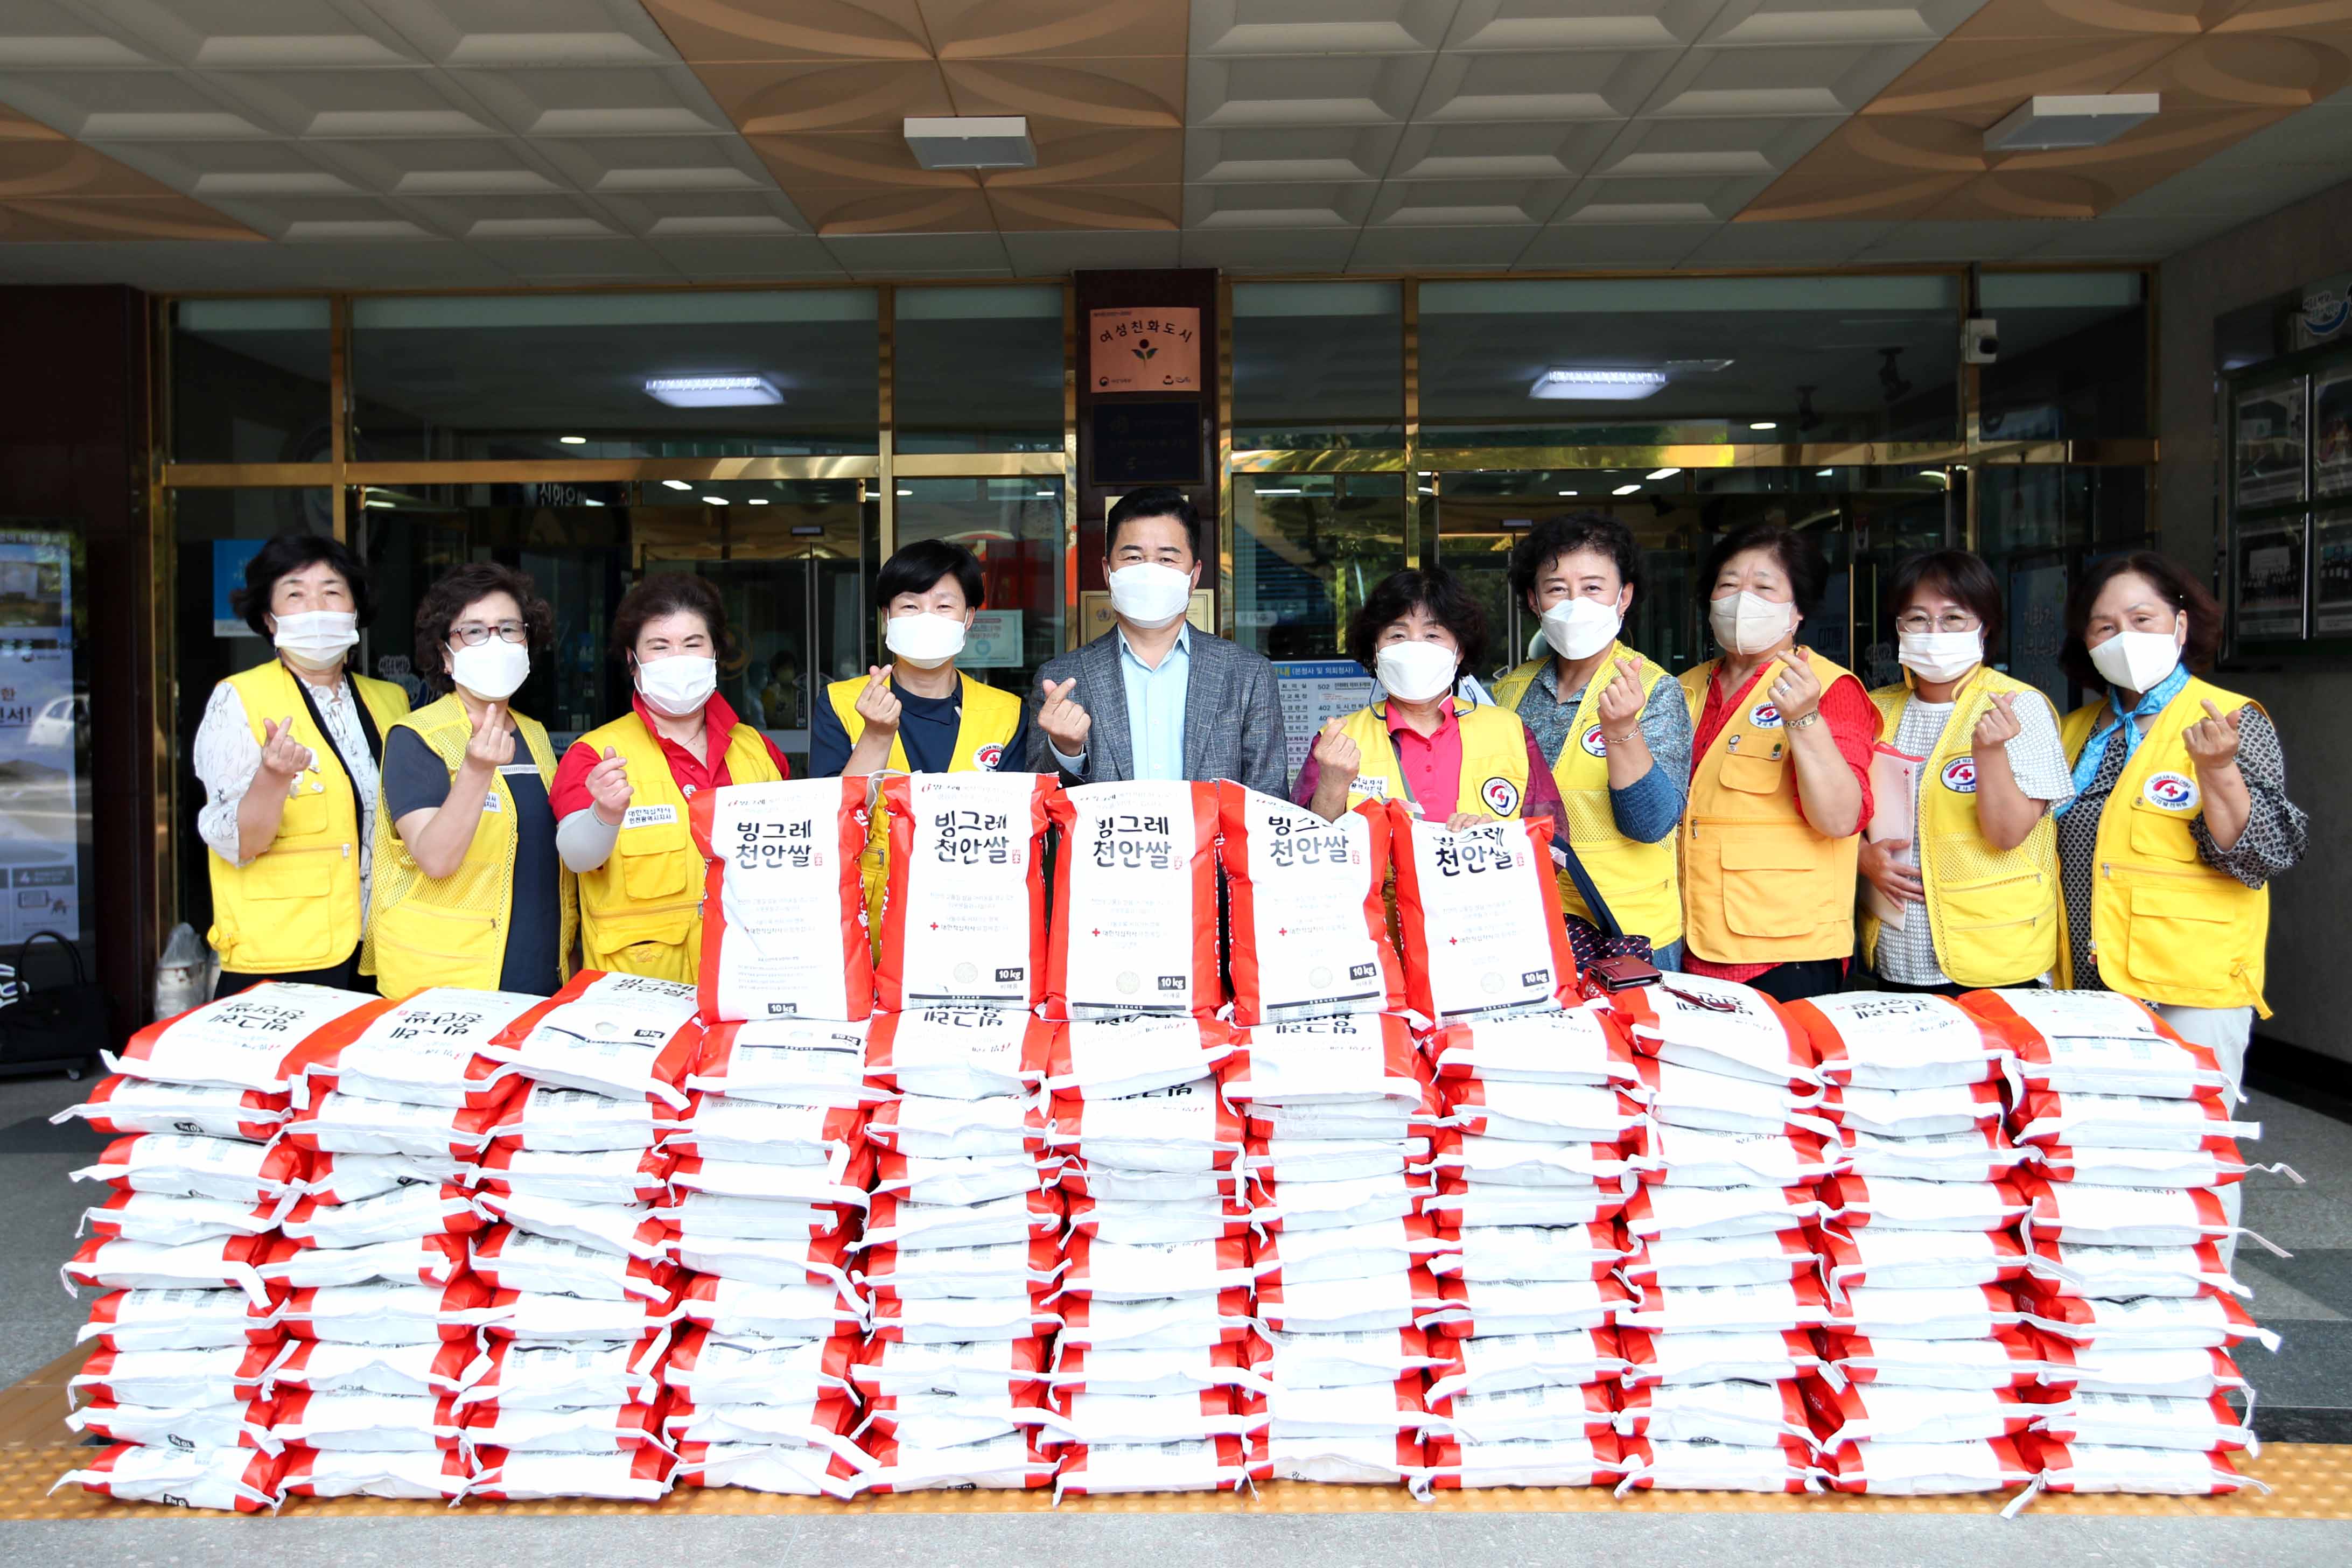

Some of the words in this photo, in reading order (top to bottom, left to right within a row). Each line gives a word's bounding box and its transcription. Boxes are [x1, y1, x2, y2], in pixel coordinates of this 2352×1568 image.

[1100, 320, 1193, 342] 여성친화도시
[628, 807, 671, 817] 대한적십자사
[737, 819, 812, 842] 빙그레
[935, 810, 1007, 838] 빙그레
[1095, 815, 1170, 839] 빙그레
[735, 844, 812, 870] 천안쌀
[933, 836, 1010, 865] 천안쌀
[1093, 840, 1172, 870] 천안쌀
[1270, 835, 1349, 867] 천안쌀
[1435, 845, 1513, 877] 천안쌀
[999, 970, 1009, 978] 10
[1010, 970, 1021, 979] kg
[1354, 968, 1362, 976] 10
[1363, 965, 1374, 976] kg
[1525, 974, 1535, 983] 10
[1536, 972, 1548, 983] kg
[1161, 978, 1171, 987] 10
[1172, 978, 1183, 989] kg
[783, 1005, 795, 1013] kg
